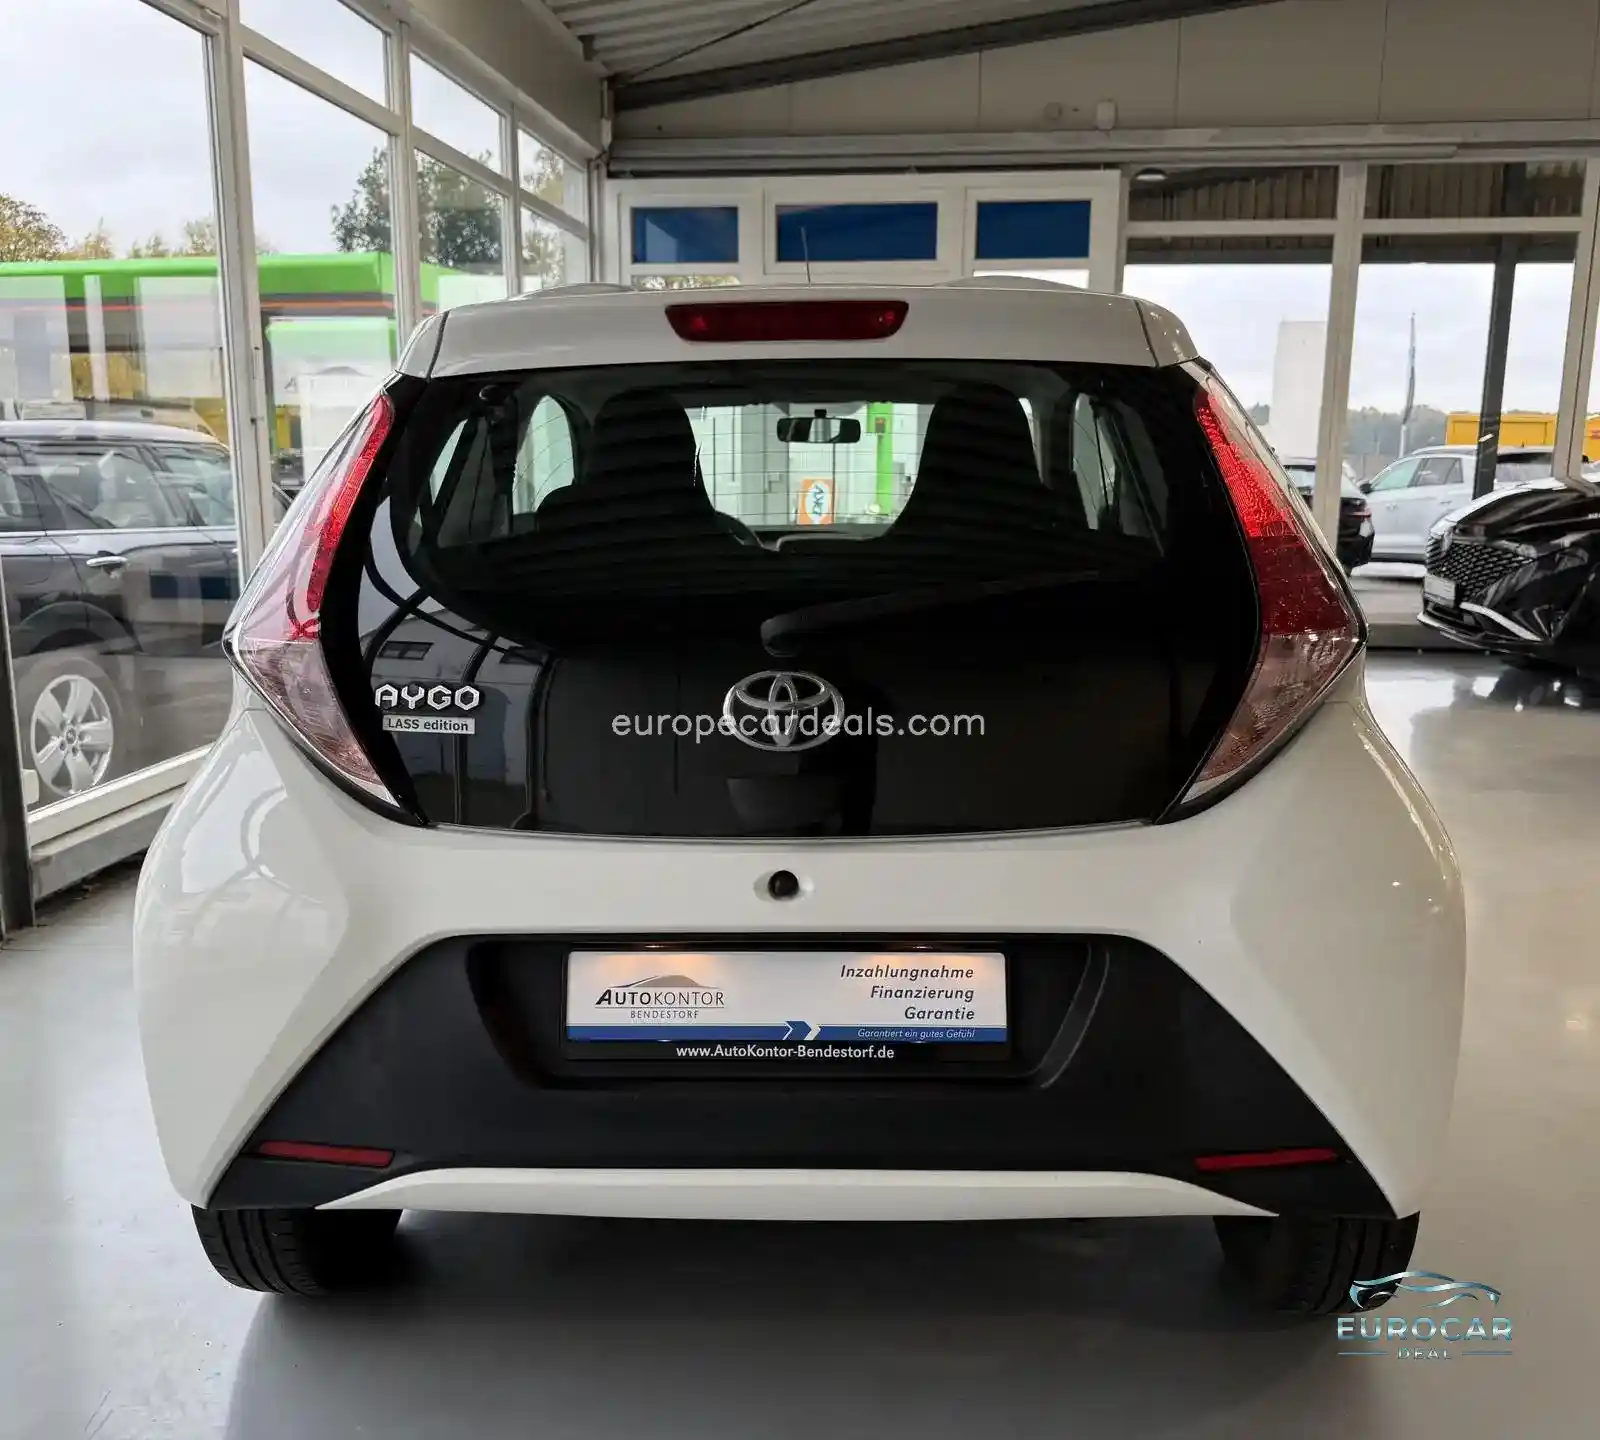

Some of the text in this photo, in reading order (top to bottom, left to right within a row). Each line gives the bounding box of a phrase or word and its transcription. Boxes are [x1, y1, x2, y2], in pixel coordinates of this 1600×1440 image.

[375, 684, 480, 711] AYGO
[423, 720, 469, 731] edition
[840, 964, 974, 981] Inzahlungnahme
[870, 985, 975, 1003] Finanzierung
[630, 1010, 700, 1019] BENDESTORF
[904, 1006, 975, 1020] Garantie
[857, 1028, 976, 1040] Garantiert ein gutes Gefühl
[676, 1044, 895, 1059] www.AutoKontor-Bendestorf.de
